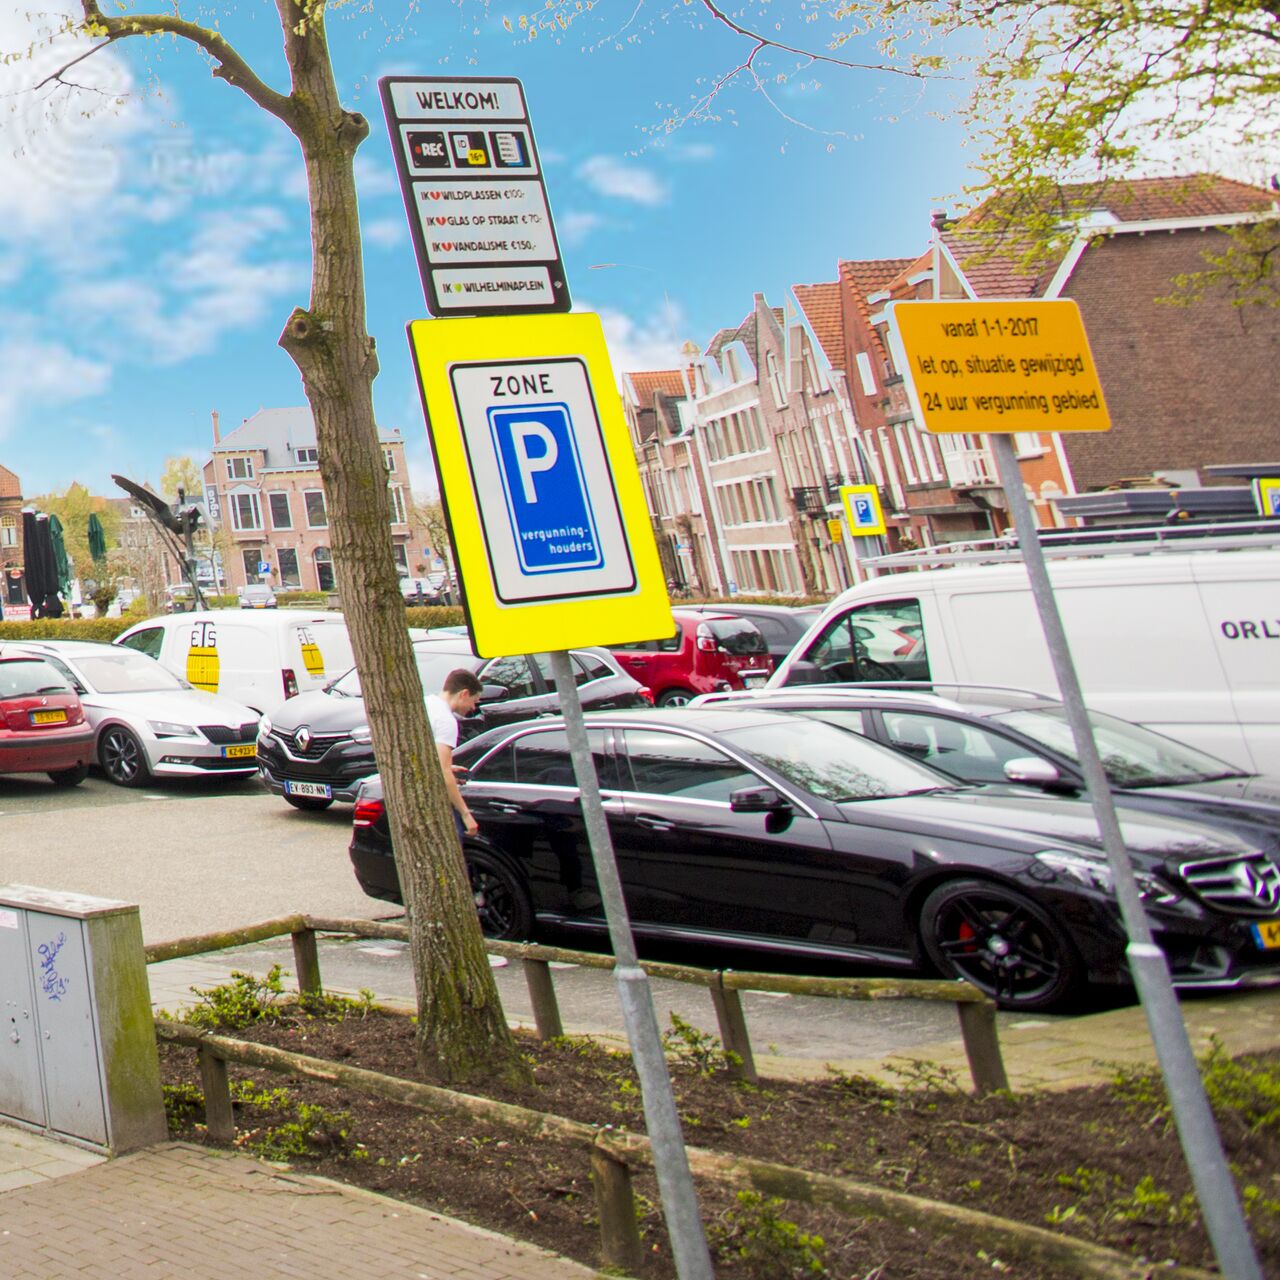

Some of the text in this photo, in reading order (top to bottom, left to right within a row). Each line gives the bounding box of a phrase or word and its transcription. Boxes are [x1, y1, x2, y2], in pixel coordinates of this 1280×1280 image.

[416, 91, 500, 110] WELKOM!
[421, 143, 445, 157] REC
[457, 140, 467, 148] ID
[420, 191, 430, 201] IK
[441, 190, 502, 200] WILDPLASSEN
[426, 216, 436, 226] IK
[447, 216, 470, 226] GLAS
[472, 216, 486, 225] OP
[487, 215, 519, 225] STRAAT
[432, 243, 442, 253] IK
[453, 241, 509, 252] VANDALISME
[442, 280, 545, 293] IK WILHELMINAPLEIN
[941, 316, 1040, 338] vanaf 1-1-2017
[917, 355, 937, 375] let
[965, 354, 1017, 374] situatie
[1021, 353, 1085, 378] gewijzigd
[490, 373, 554, 397] ZONE
[923, 390, 1100, 414] 24 uur vergunning gebied
[509, 420, 559, 504] P
[857, 501, 868, 515] P
[521, 526, 589, 541] vergunning-
[549, 541, 593, 555] houders
[1220, 619, 1280, 640] ORL
